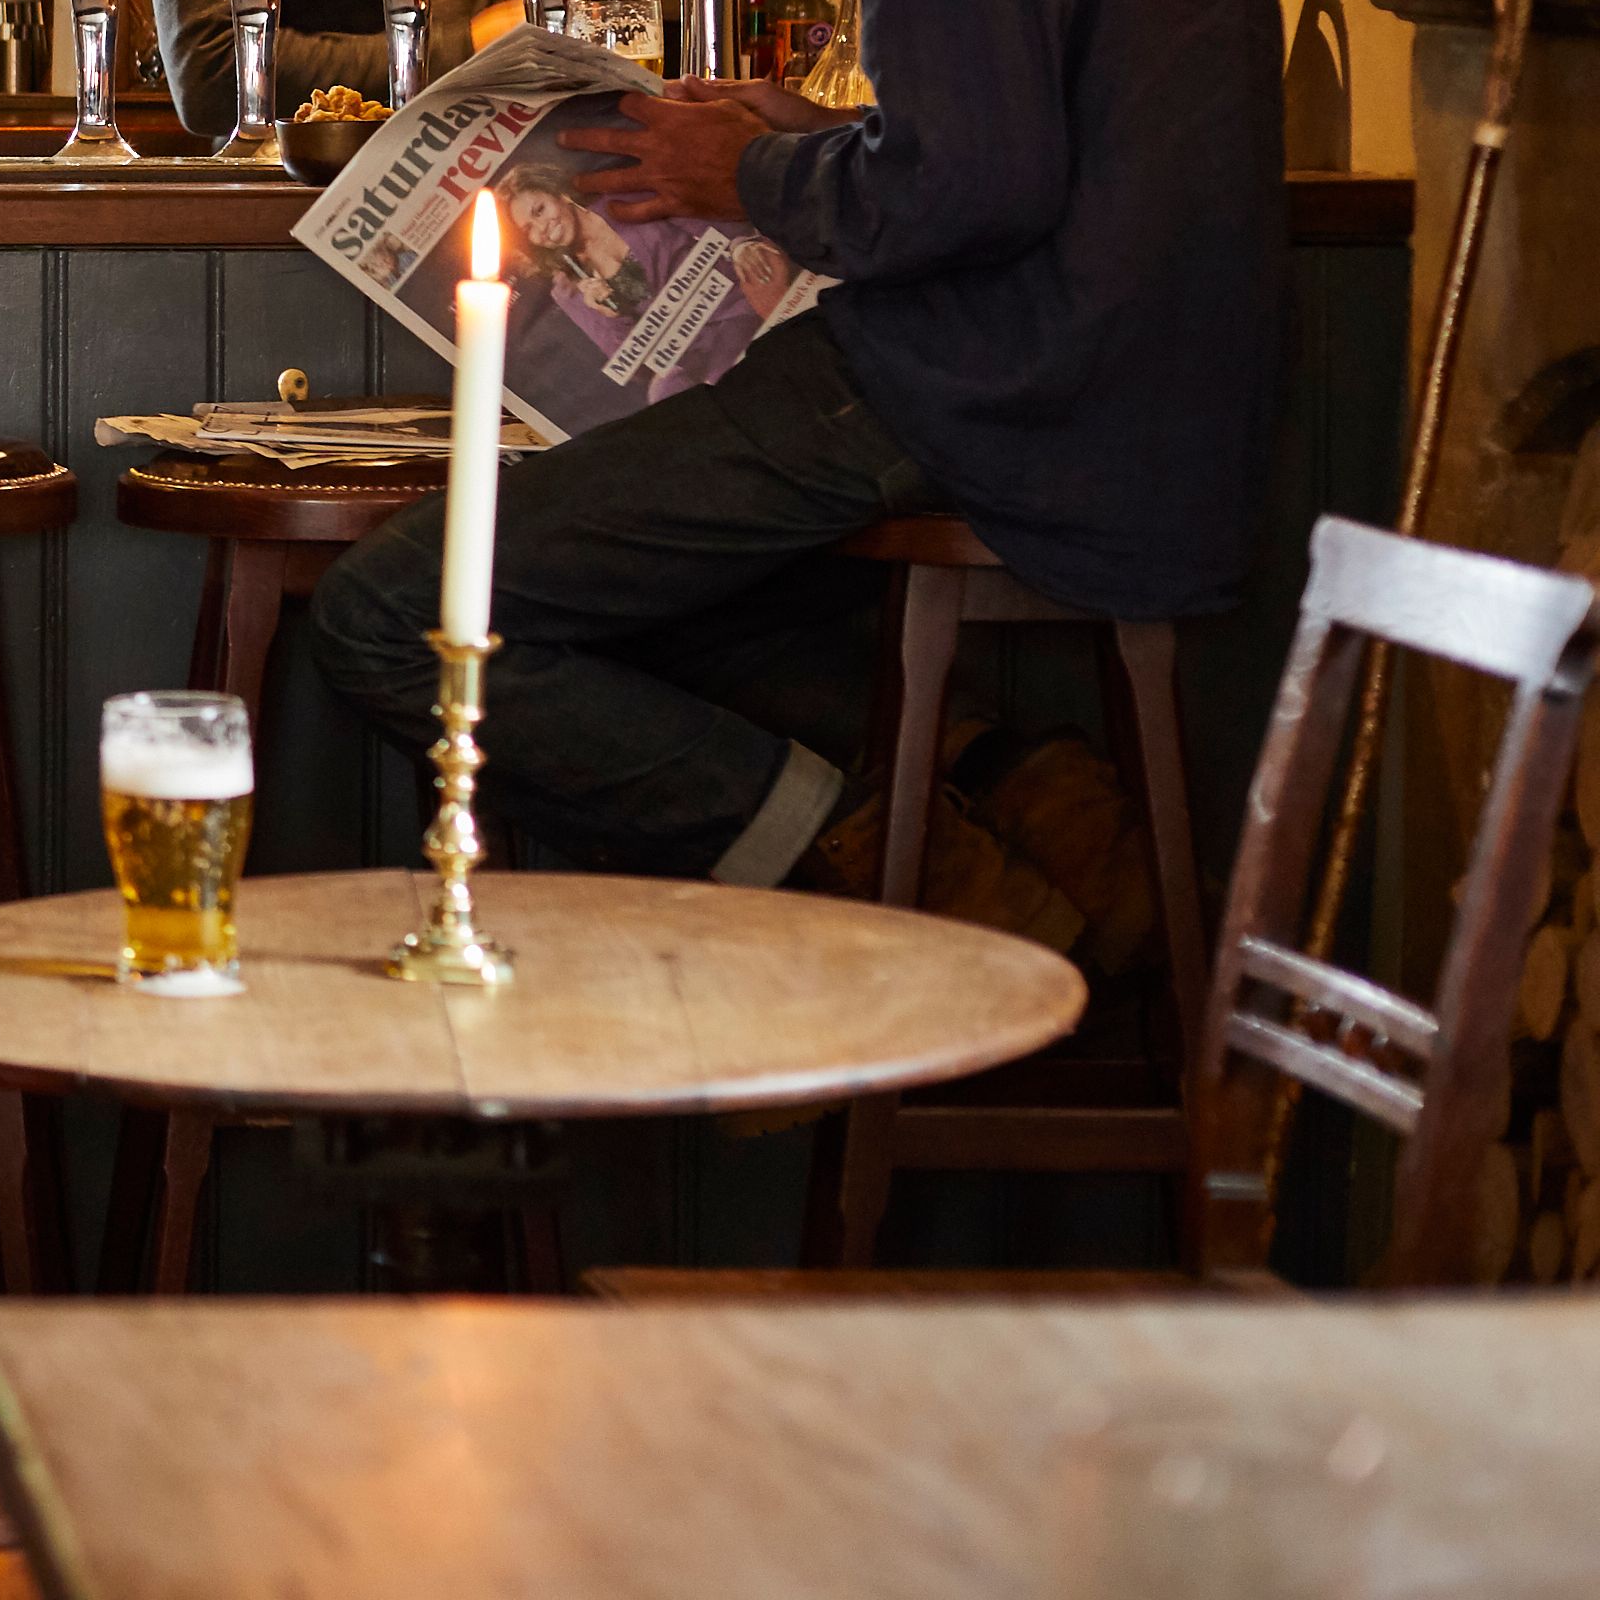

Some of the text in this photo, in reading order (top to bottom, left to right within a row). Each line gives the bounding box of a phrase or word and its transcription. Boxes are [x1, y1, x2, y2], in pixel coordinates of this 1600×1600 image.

[328, 95, 501, 262] saturday
[437, 99, 545, 205] revie
[609, 237, 729, 379] Michelle Obama,
[652, 275, 726, 370] the movie!
